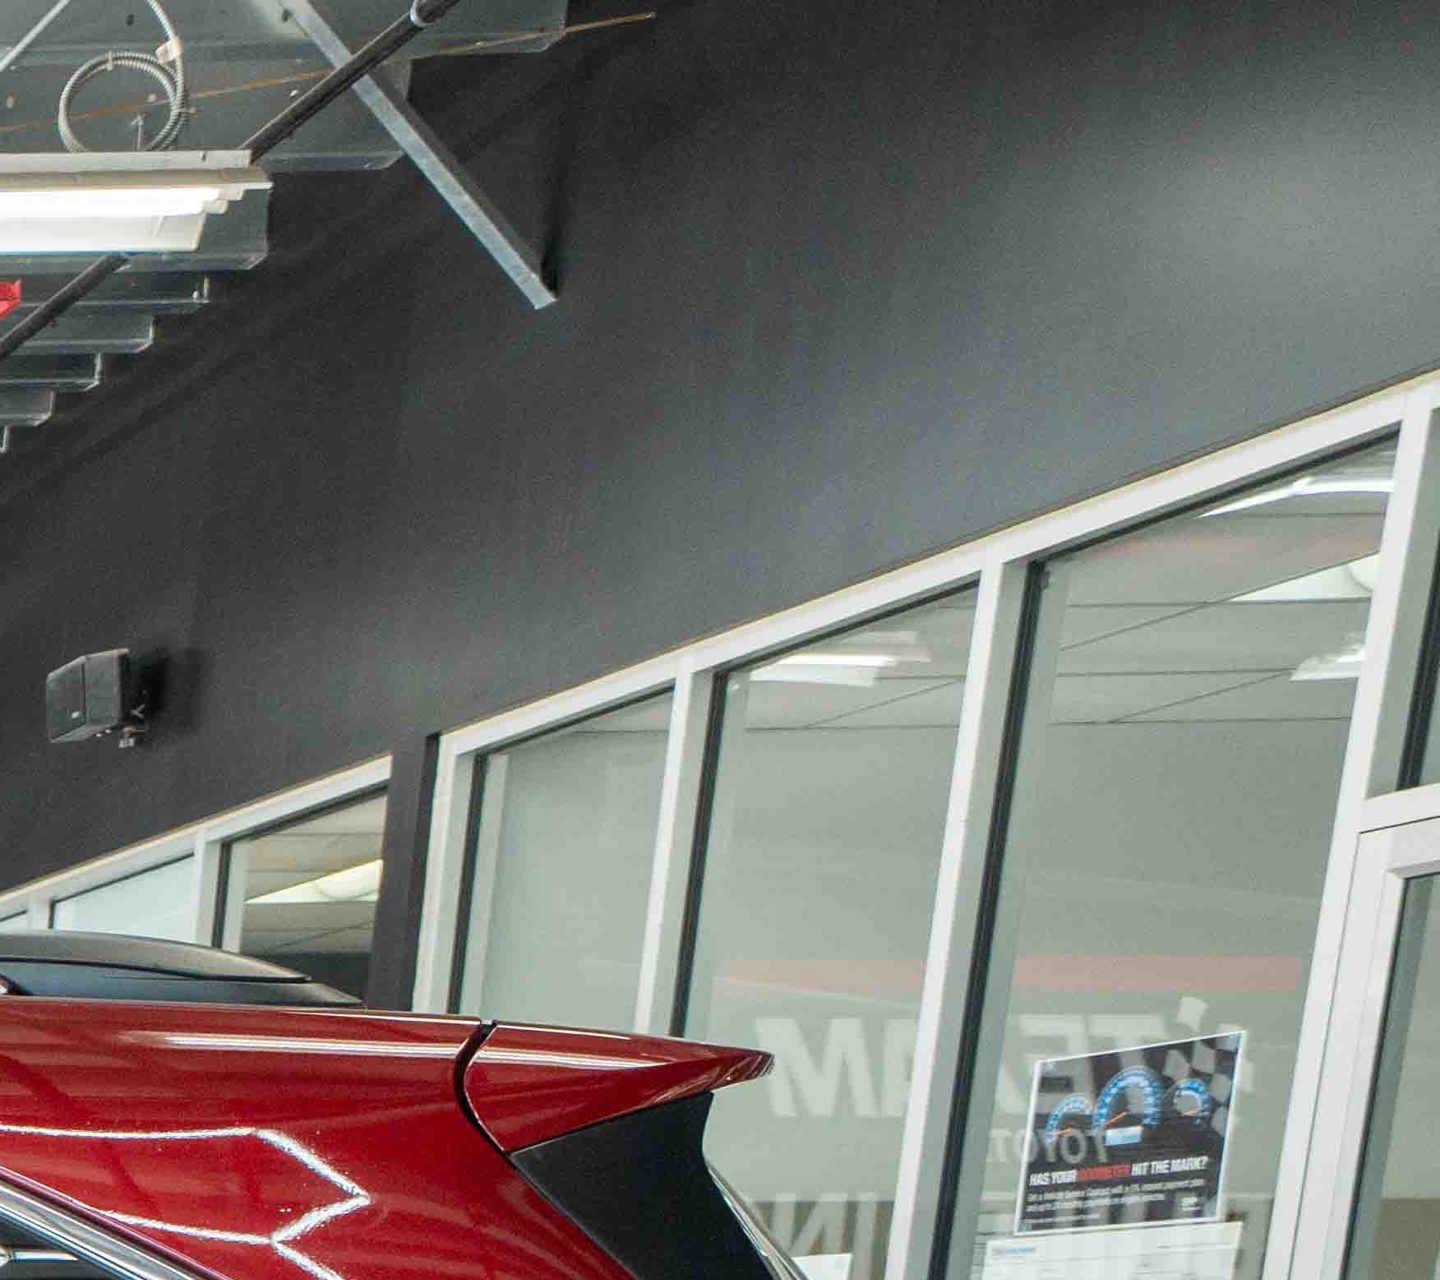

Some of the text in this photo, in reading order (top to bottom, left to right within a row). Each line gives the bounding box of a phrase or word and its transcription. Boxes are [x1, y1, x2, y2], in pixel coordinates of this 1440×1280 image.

[1029, 1173, 1051, 1187] HAS
[1131, 1163, 1151, 1177] HIT
[1150, 1160, 1171, 1174] THE
[1171, 1156, 1209, 1173] MARK?
